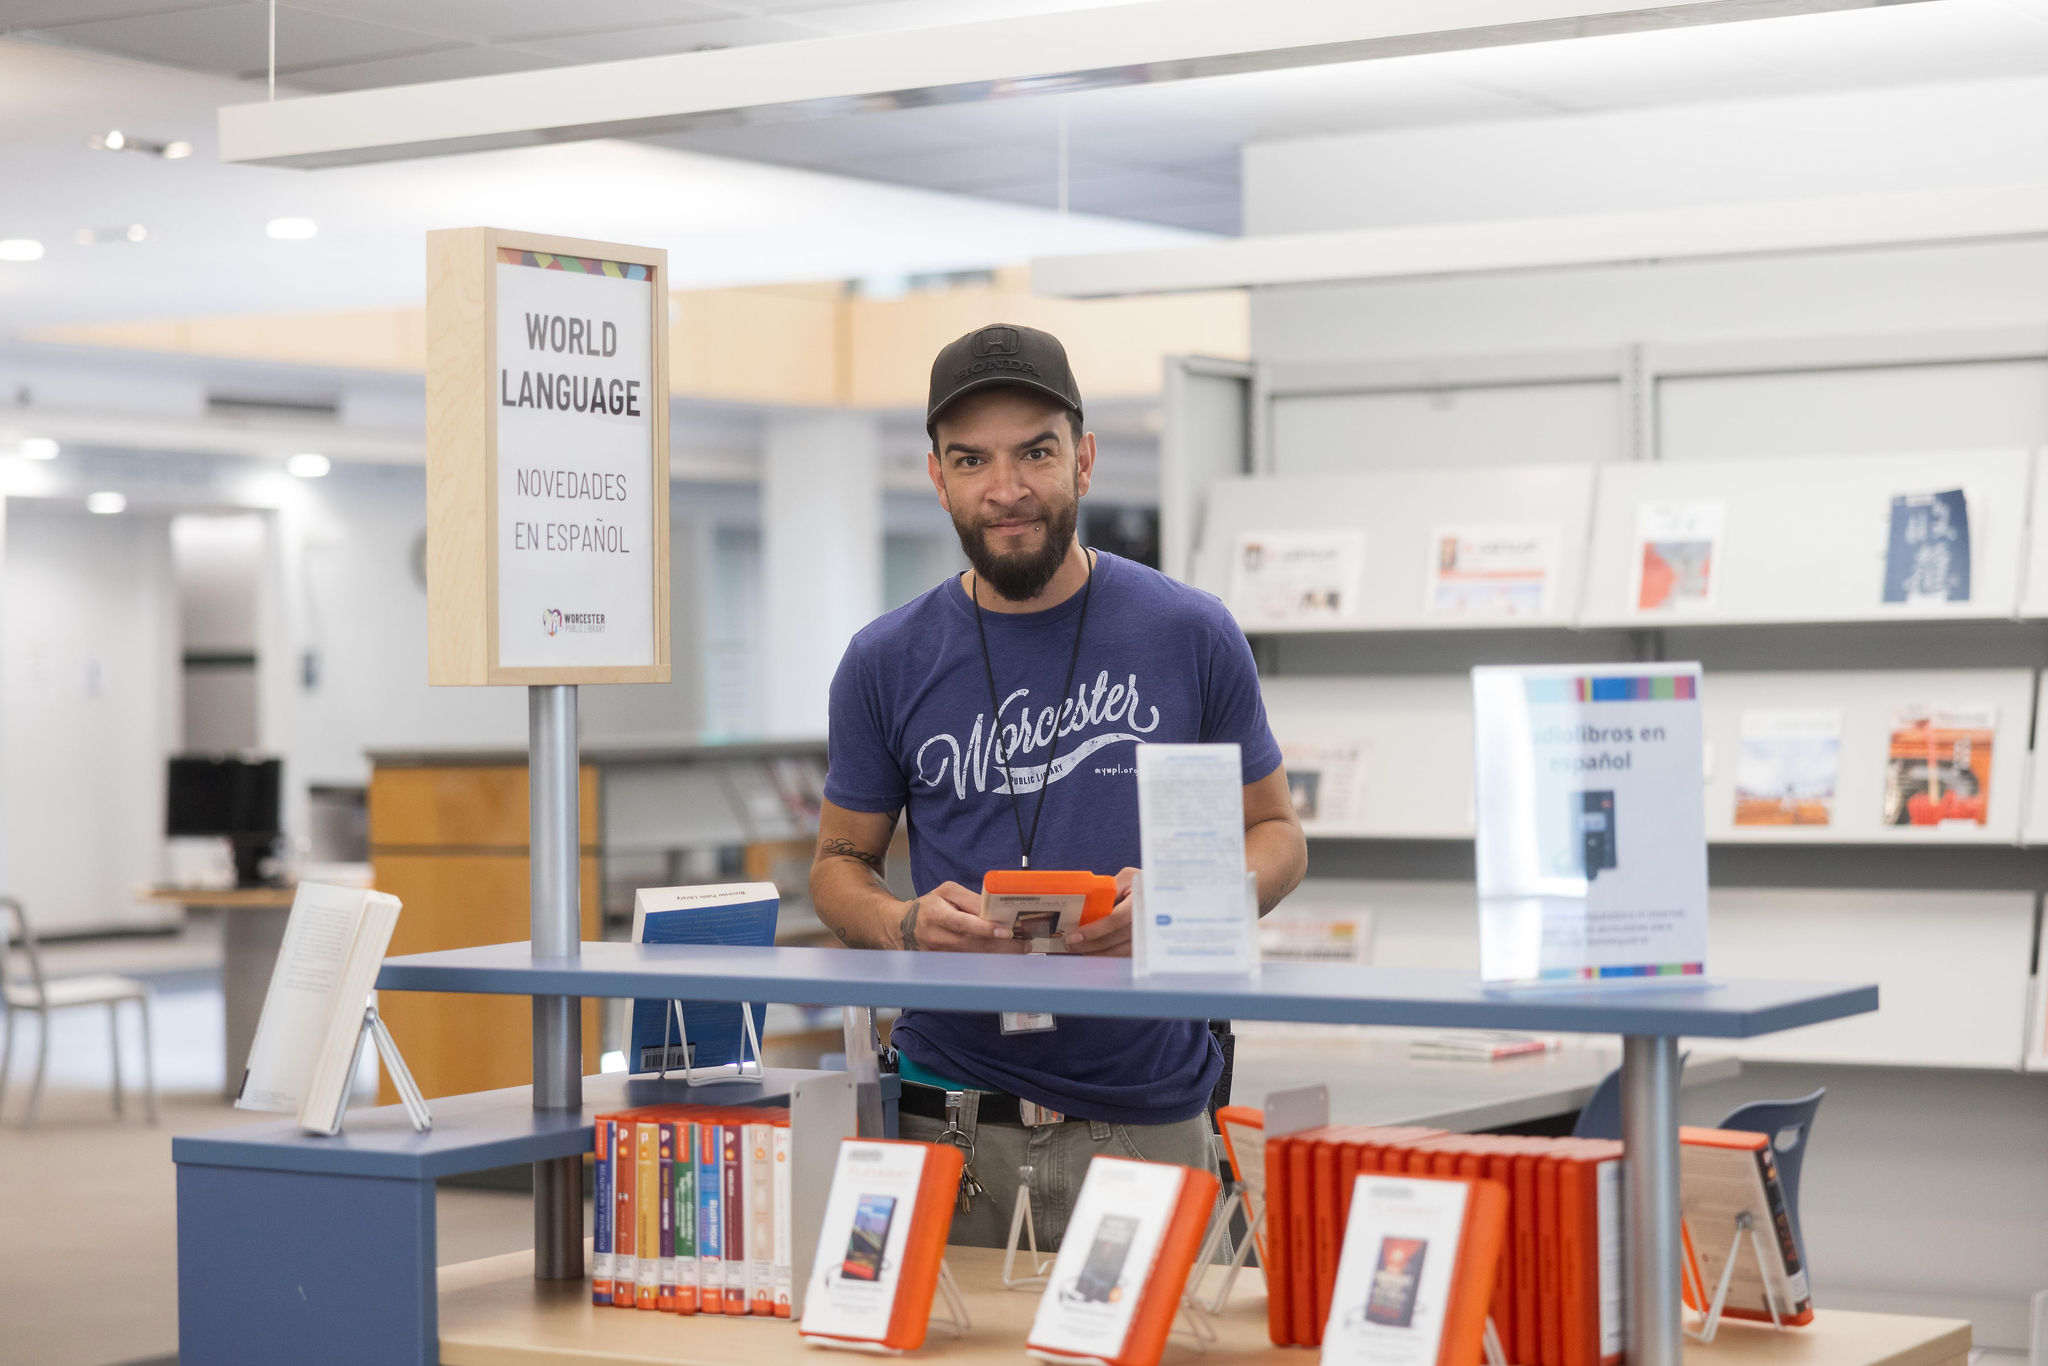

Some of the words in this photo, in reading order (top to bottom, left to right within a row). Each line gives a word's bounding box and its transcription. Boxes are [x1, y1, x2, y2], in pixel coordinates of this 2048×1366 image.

[525, 313, 617, 358] WORLD
[955, 359, 1041, 383] HONDA
[501, 369, 641, 416] LANGUAGE
[517, 468, 627, 502] NOVEDADES
[515, 522, 539, 551] EN
[546, 518, 630, 553] ESPAÑOL
[564, 613, 606, 624] WORCESTER
[916, 670, 1160, 800] Worcester
[1639, 726, 1666, 742] en
[1036, 763, 1063, 782] LIARY
